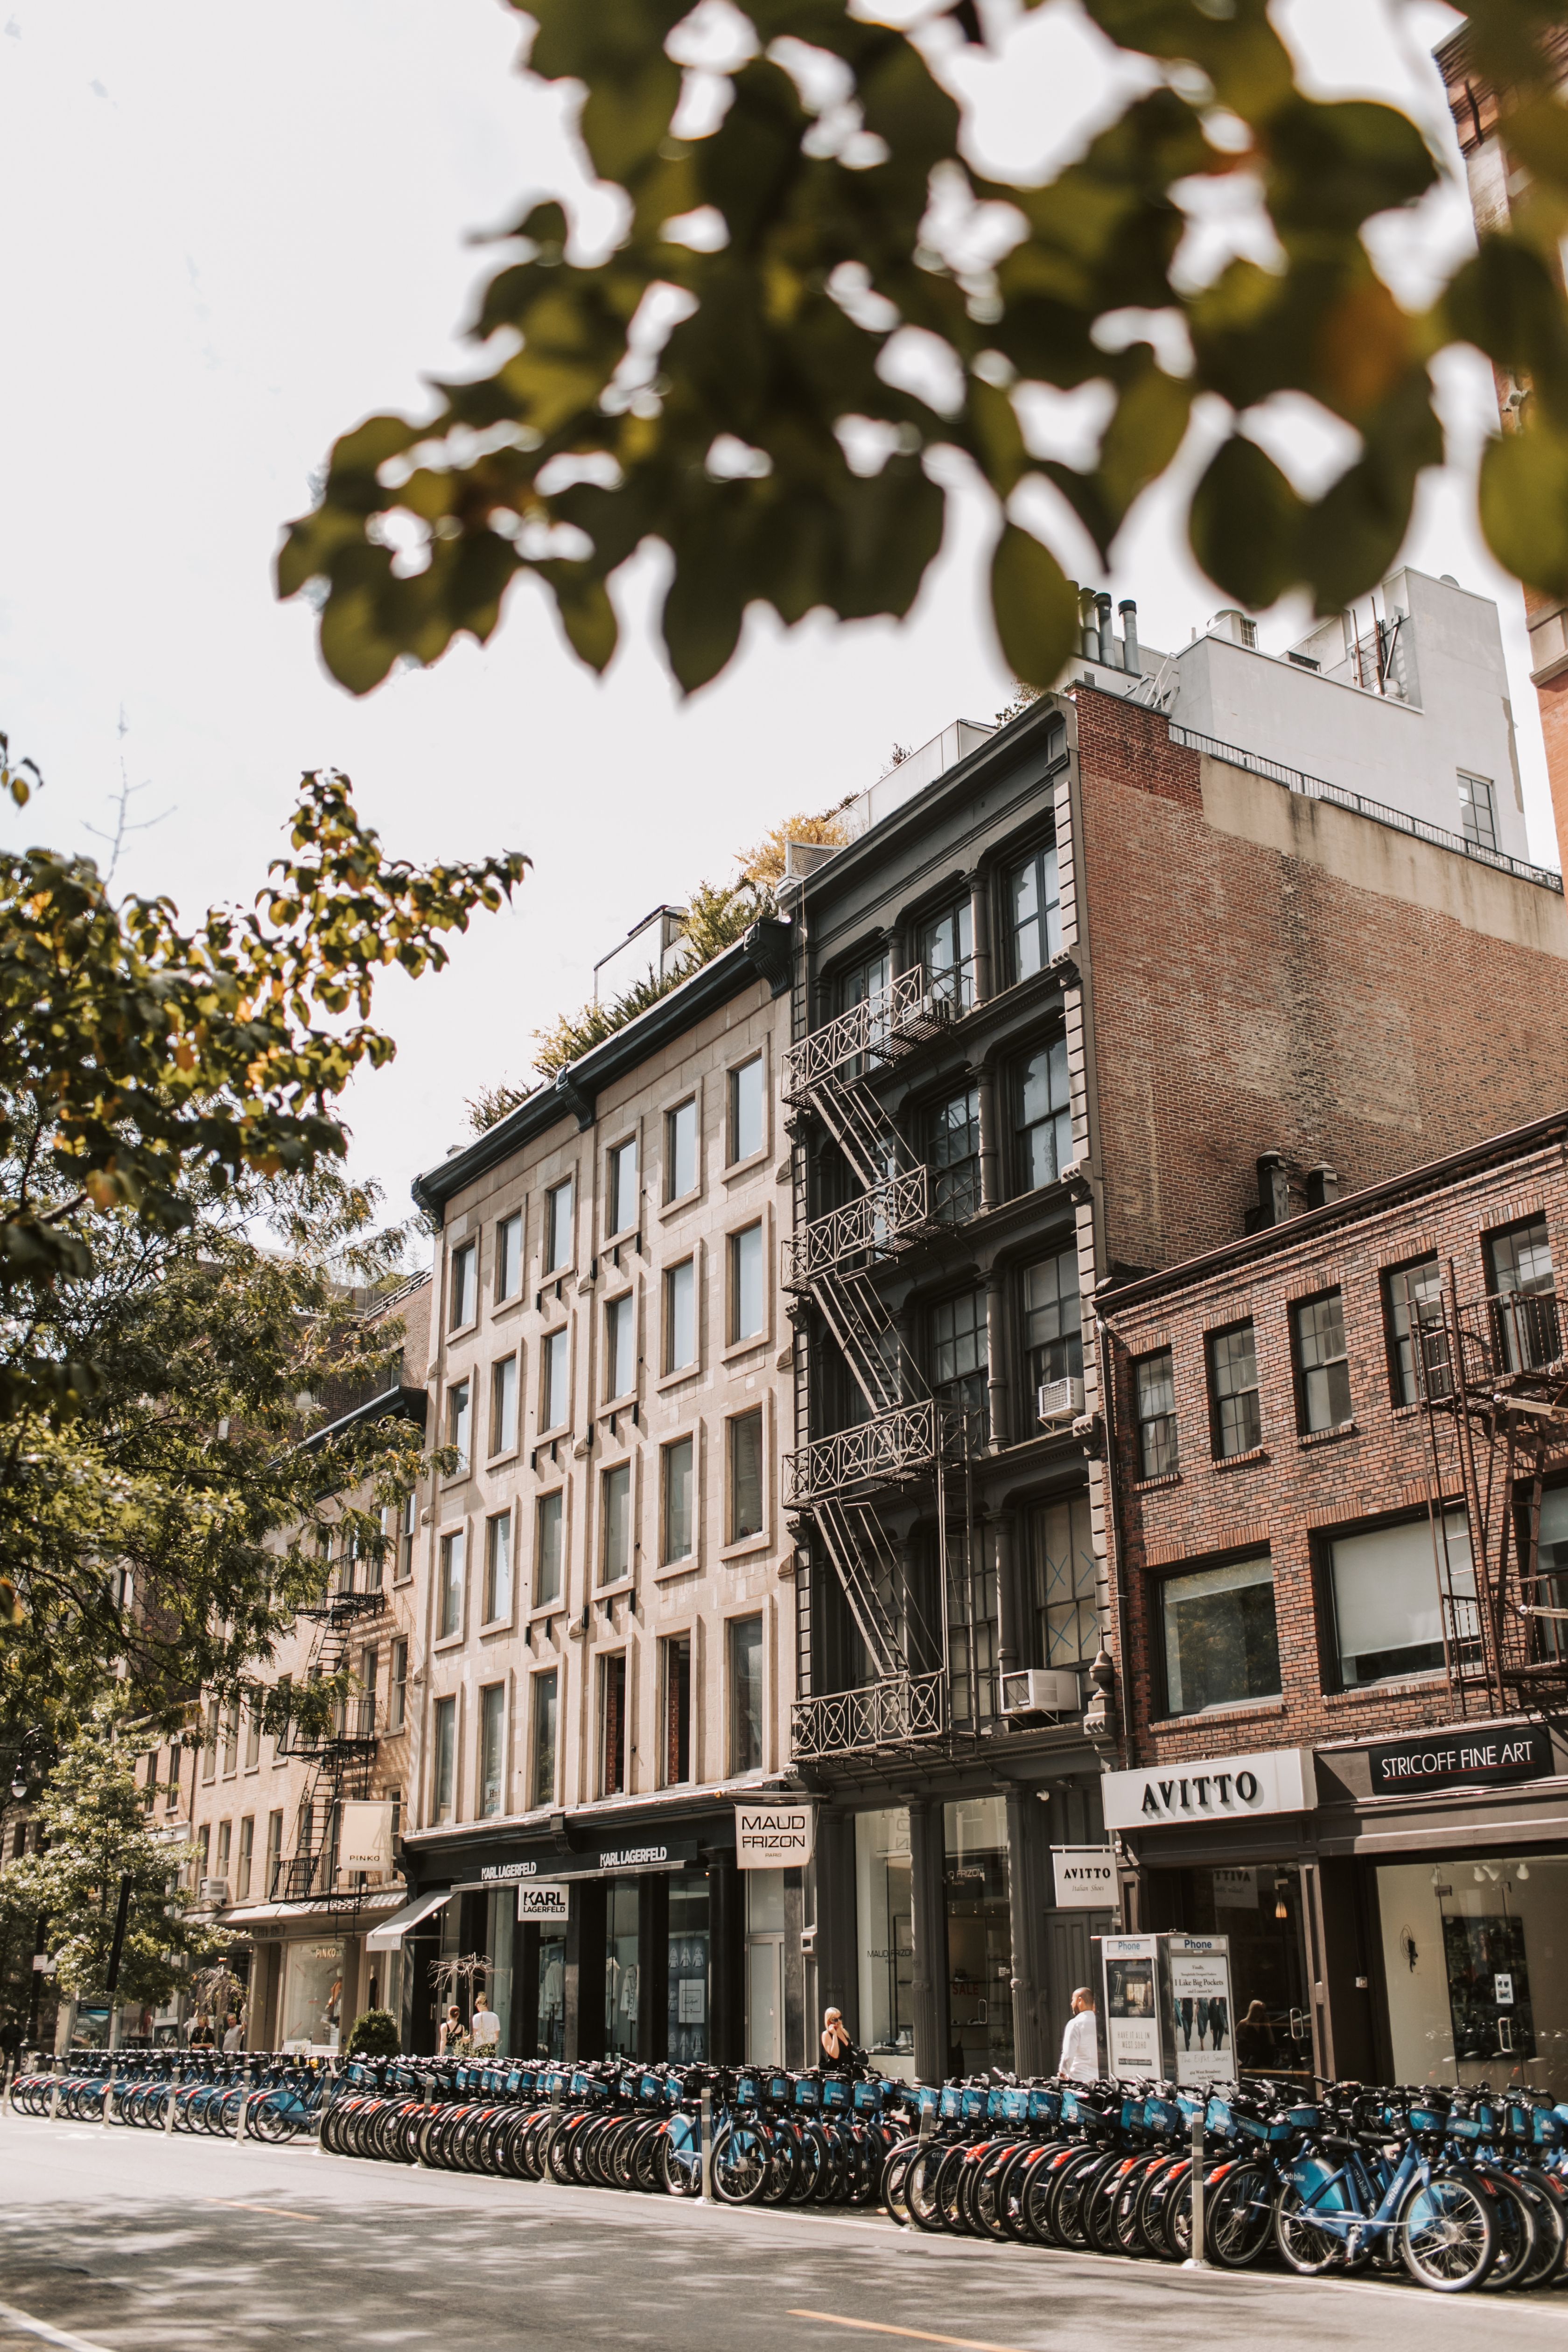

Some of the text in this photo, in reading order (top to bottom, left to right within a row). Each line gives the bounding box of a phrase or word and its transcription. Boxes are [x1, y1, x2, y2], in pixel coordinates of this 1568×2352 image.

[1381, 1741, 1533, 1778] STRICOFF FINE ART
[1141, 1771, 1257, 1811] AVITTO
[742, 1816, 805, 1830] MAUD
[742, 1835, 805, 1848] FRIZON
[600, 1847, 667, 1868] KARL LAGERFELD
[482, 1862, 537, 1880] KARL LAGERFELD
[1064, 1868, 1111, 1879] AVITTO
[524, 1892, 566, 1905] KARL
[1118, 1941, 1140, 1950] Phone
[1184, 1939, 1212, 1948] Phone
[315, 1947, 336, 1958] PINKO
[952, 1983, 979, 1995] SALE
[1192, 1979, 1203, 1988] Big
[1179, 2055, 1191, 2063] The
